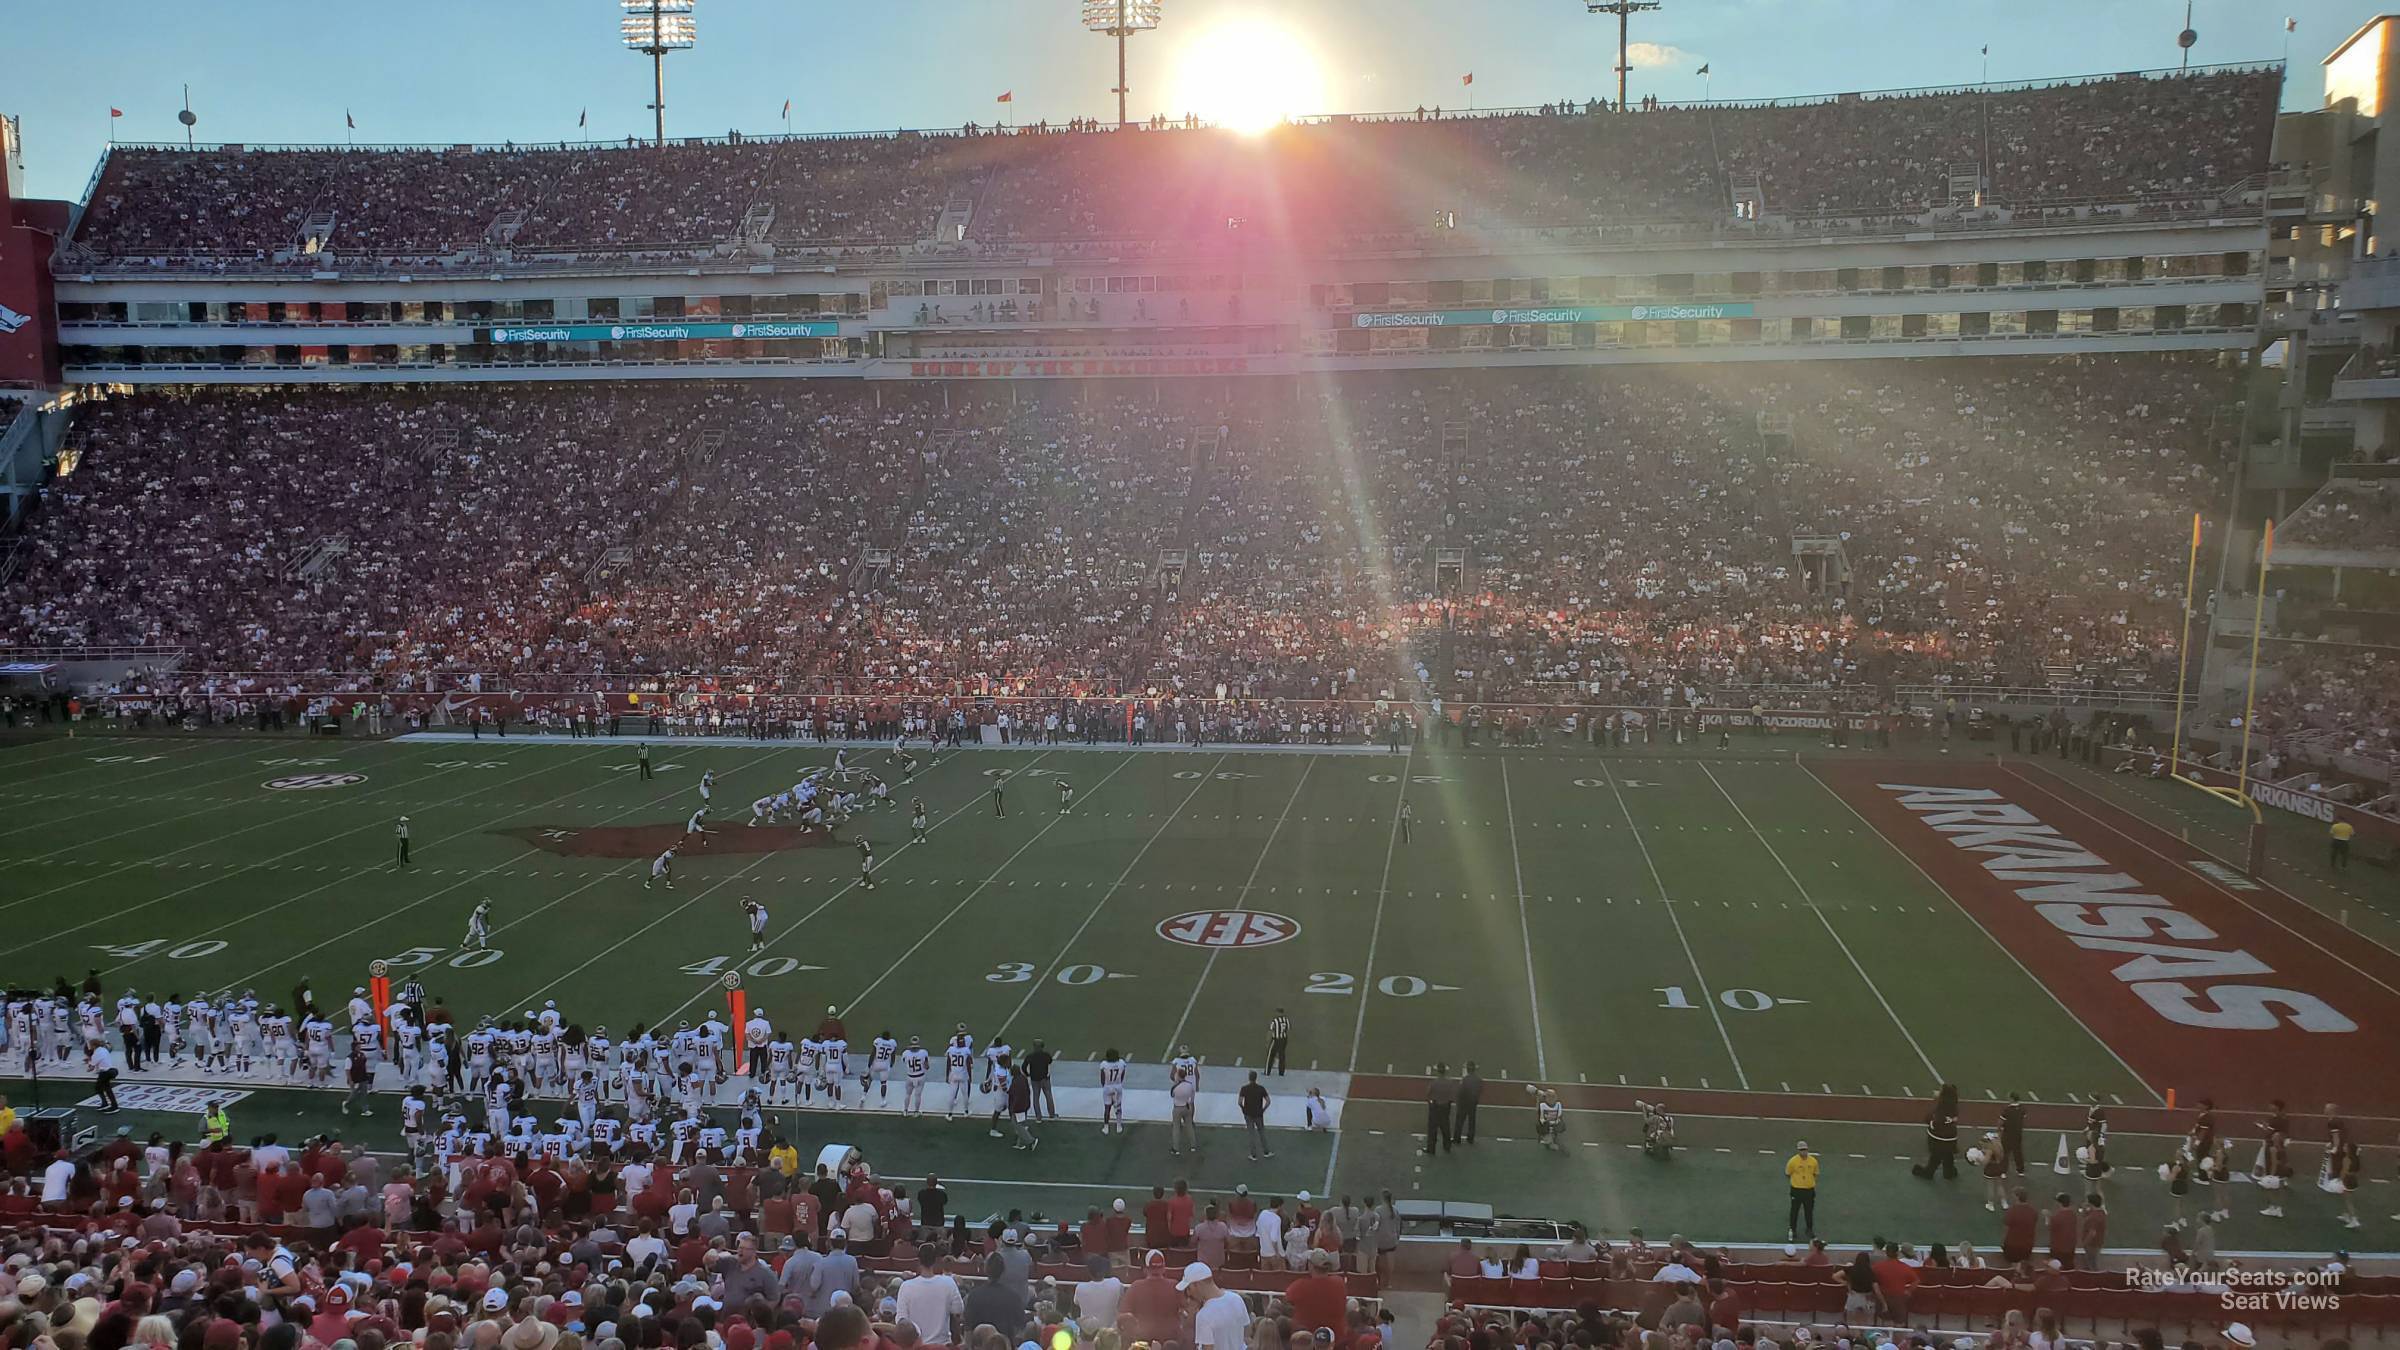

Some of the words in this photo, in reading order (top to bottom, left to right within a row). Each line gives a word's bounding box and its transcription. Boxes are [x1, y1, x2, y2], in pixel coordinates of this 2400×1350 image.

[1509, 310, 1581, 323] FirstSecurity
[1649, 306, 1723, 319] FirstSecurity
[1374, 313, 1444, 326] FirstSecurity
[508, 329, 570, 341] FirstSecurity
[625, 326, 689, 339] FirstSecurity
[747, 324, 812, 337] FirstSecurity
[2251, 783, 2335, 823] ARKANSAS
[1876, 784, 2358, 1033] ARKANSAS
[107, 939, 229, 959] 40
[385, 947, 505, 968] 50
[679, 956, 798, 977] 40
[985, 963, 1105, 985] 30
[1304, 973, 1427, 997] 20
[1653, 987, 1773, 1011] 10
[360, 1034, 372, 1044] 57
[472, 1043, 484, 1055] 92
[699, 1045, 709, 1056] 81
[829, 1049, 839, 1060] 10
[878, 1047, 891, 1060] 36
[909, 1058, 922, 1072] 45
[952, 1055, 964, 1067] 20
[1110, 1069, 1119, 1081] 17
